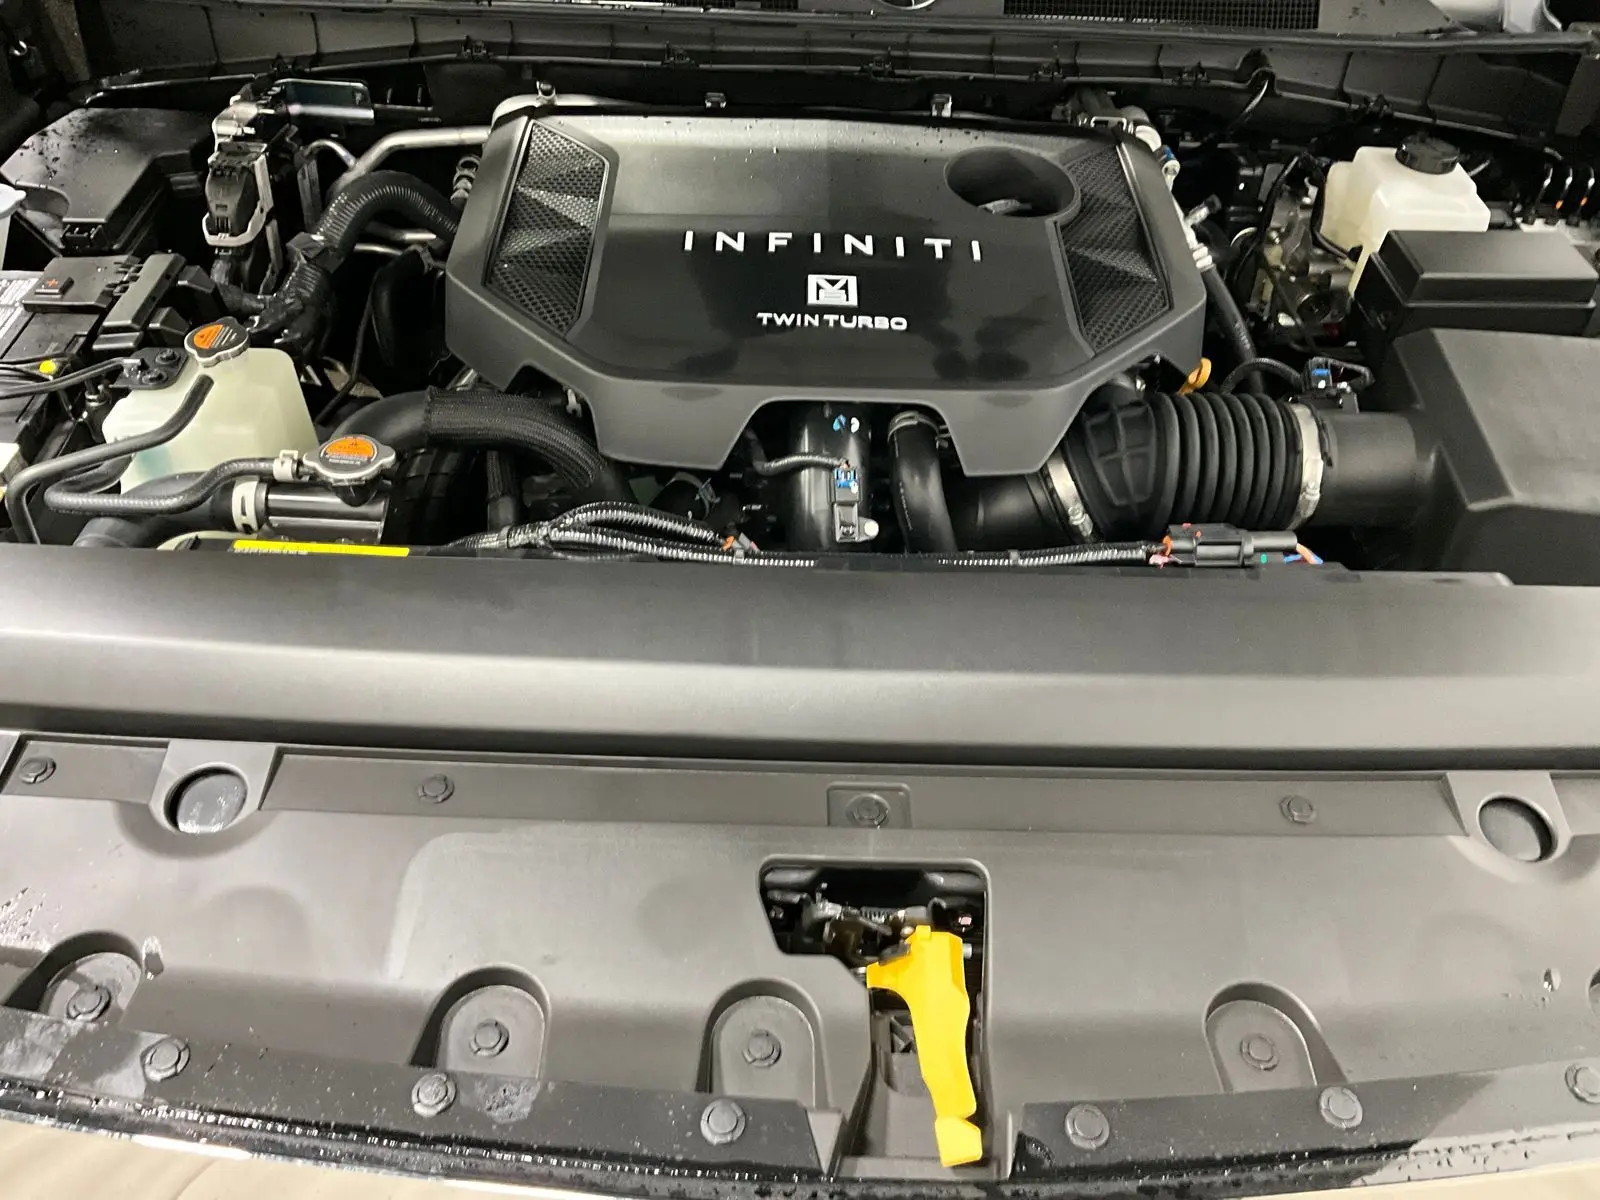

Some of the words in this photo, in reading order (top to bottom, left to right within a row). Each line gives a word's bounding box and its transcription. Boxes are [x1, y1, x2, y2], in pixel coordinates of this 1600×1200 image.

[684, 230, 982, 262] INFINITI
[756, 312, 820, 327] TWIN
[823, 314, 908, 331] TURBO
